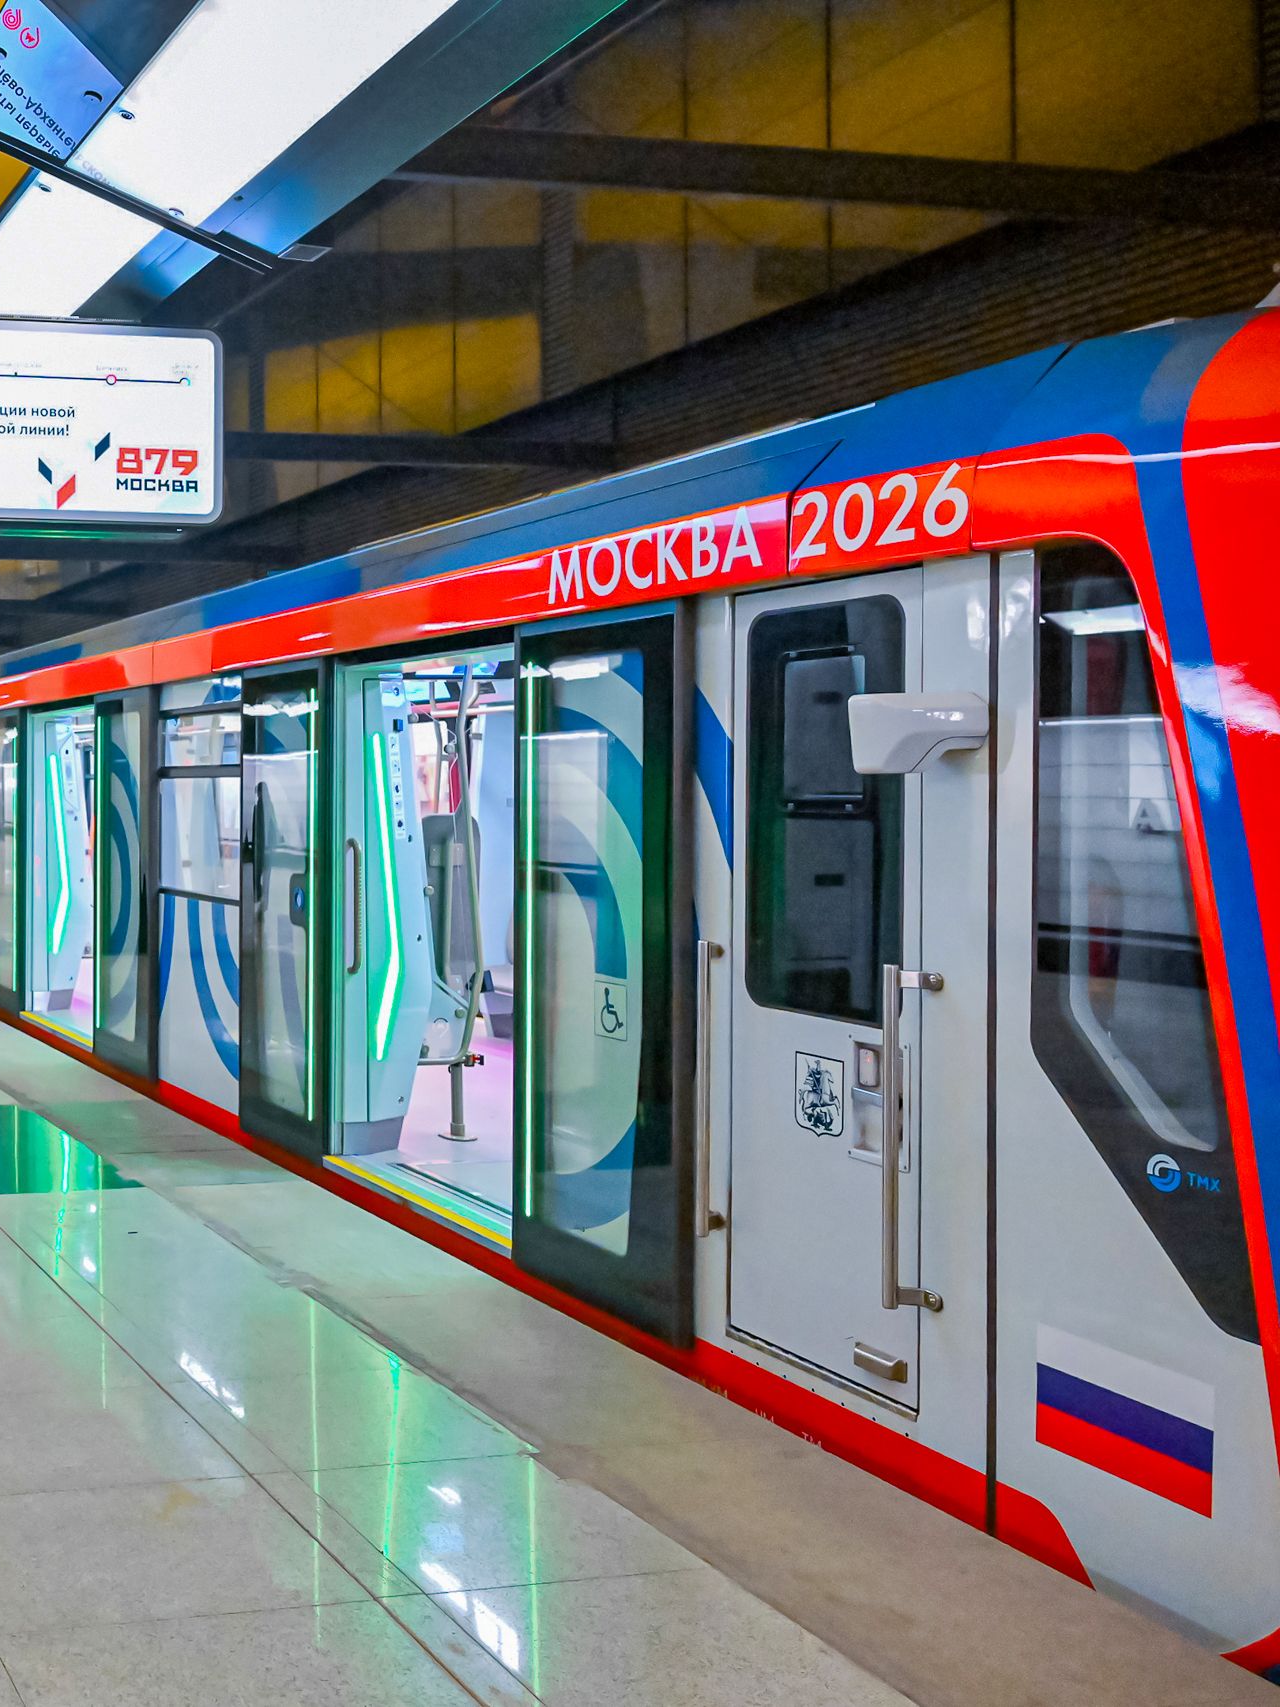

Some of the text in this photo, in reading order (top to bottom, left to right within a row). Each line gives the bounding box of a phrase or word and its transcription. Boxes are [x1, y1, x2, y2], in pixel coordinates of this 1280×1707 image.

[31, 406, 76, 418] новой
[19, 423, 70, 437] линии!
[116, 447, 199, 476] 879
[116, 478, 199, 493] МОСКВА
[548, 461, 970, 605] МОСКВА 2026
